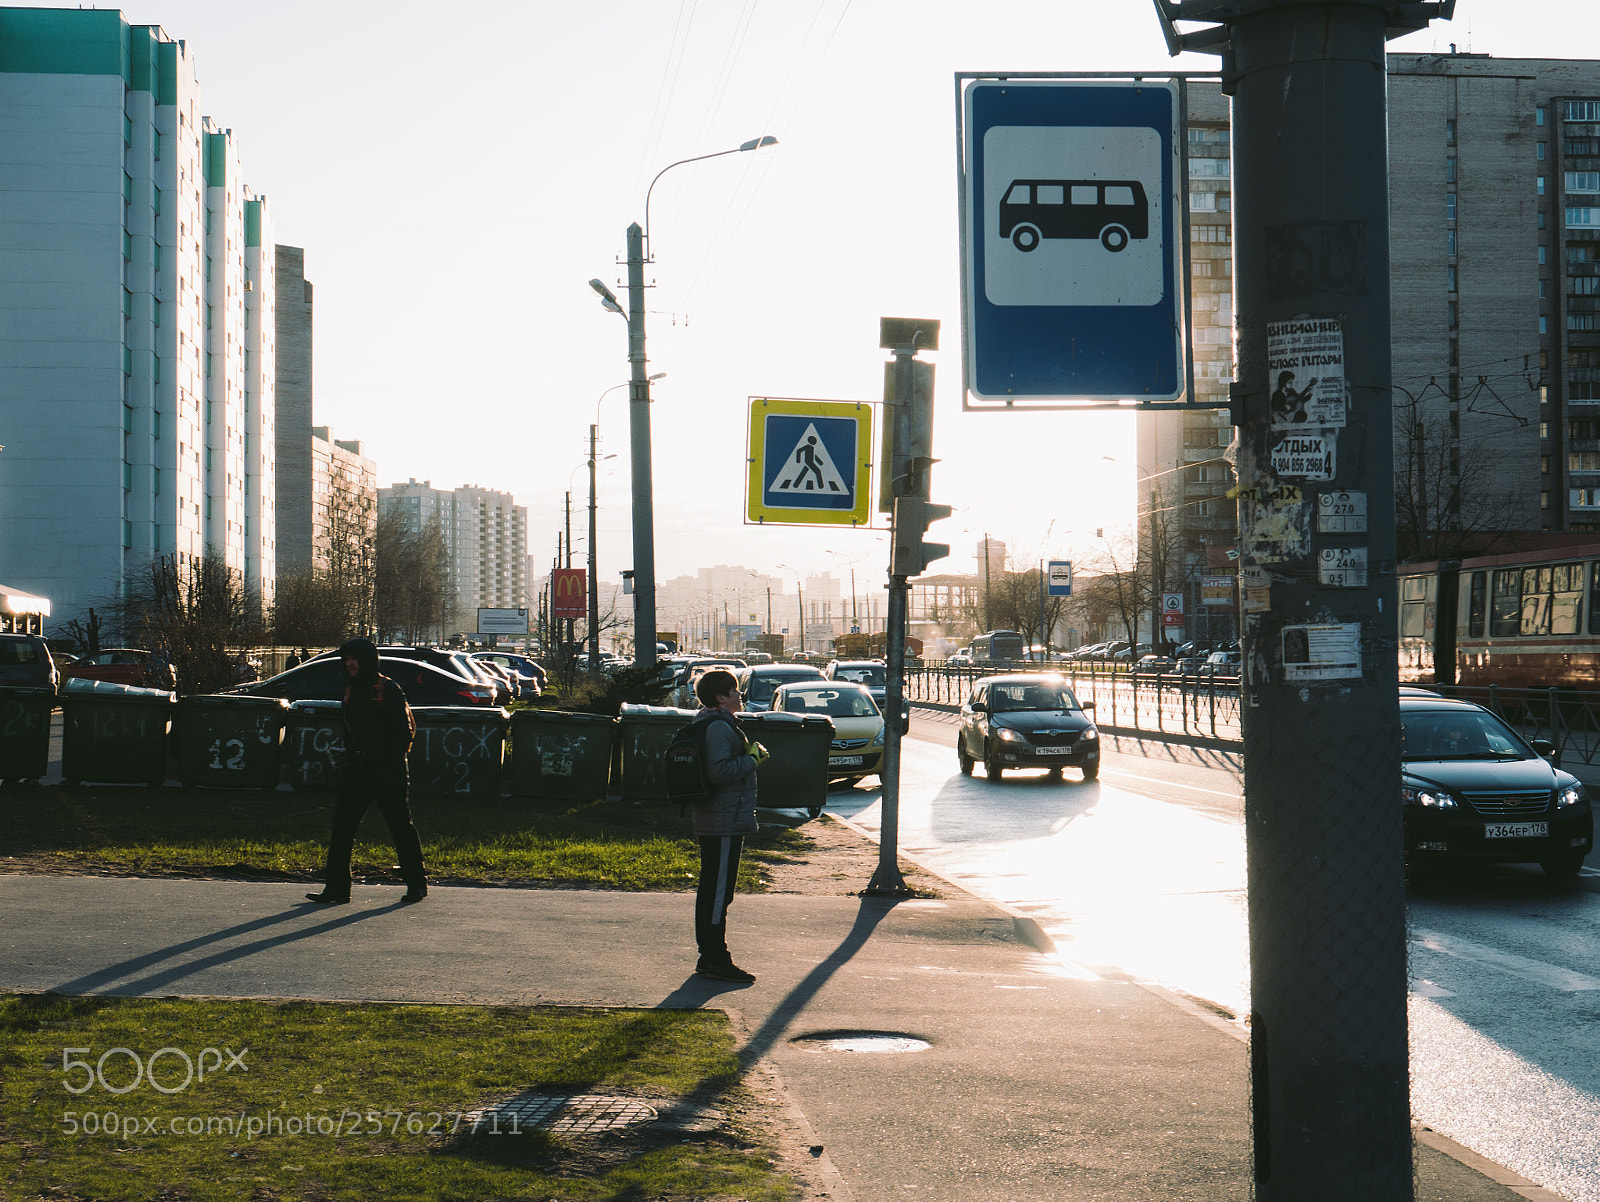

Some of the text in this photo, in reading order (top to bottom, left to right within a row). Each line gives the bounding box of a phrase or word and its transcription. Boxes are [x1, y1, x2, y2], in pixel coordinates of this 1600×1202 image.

[1268, 321, 1340, 337] ВНИМАНИЕ
[1269, 354, 1342, 370] КЛАСС ГИТАРЫ
[1278, 457, 1290, 473] 904
[1291, 457, 1305, 472] 856
[1306, 457, 1323, 473] 2968
[1334, 504, 1355, 514] 27.0
[1329, 574, 1343, 584] 0.5
[208, 738, 246, 771] 12
[1487, 823, 1546, 837] У364ЕР 178
